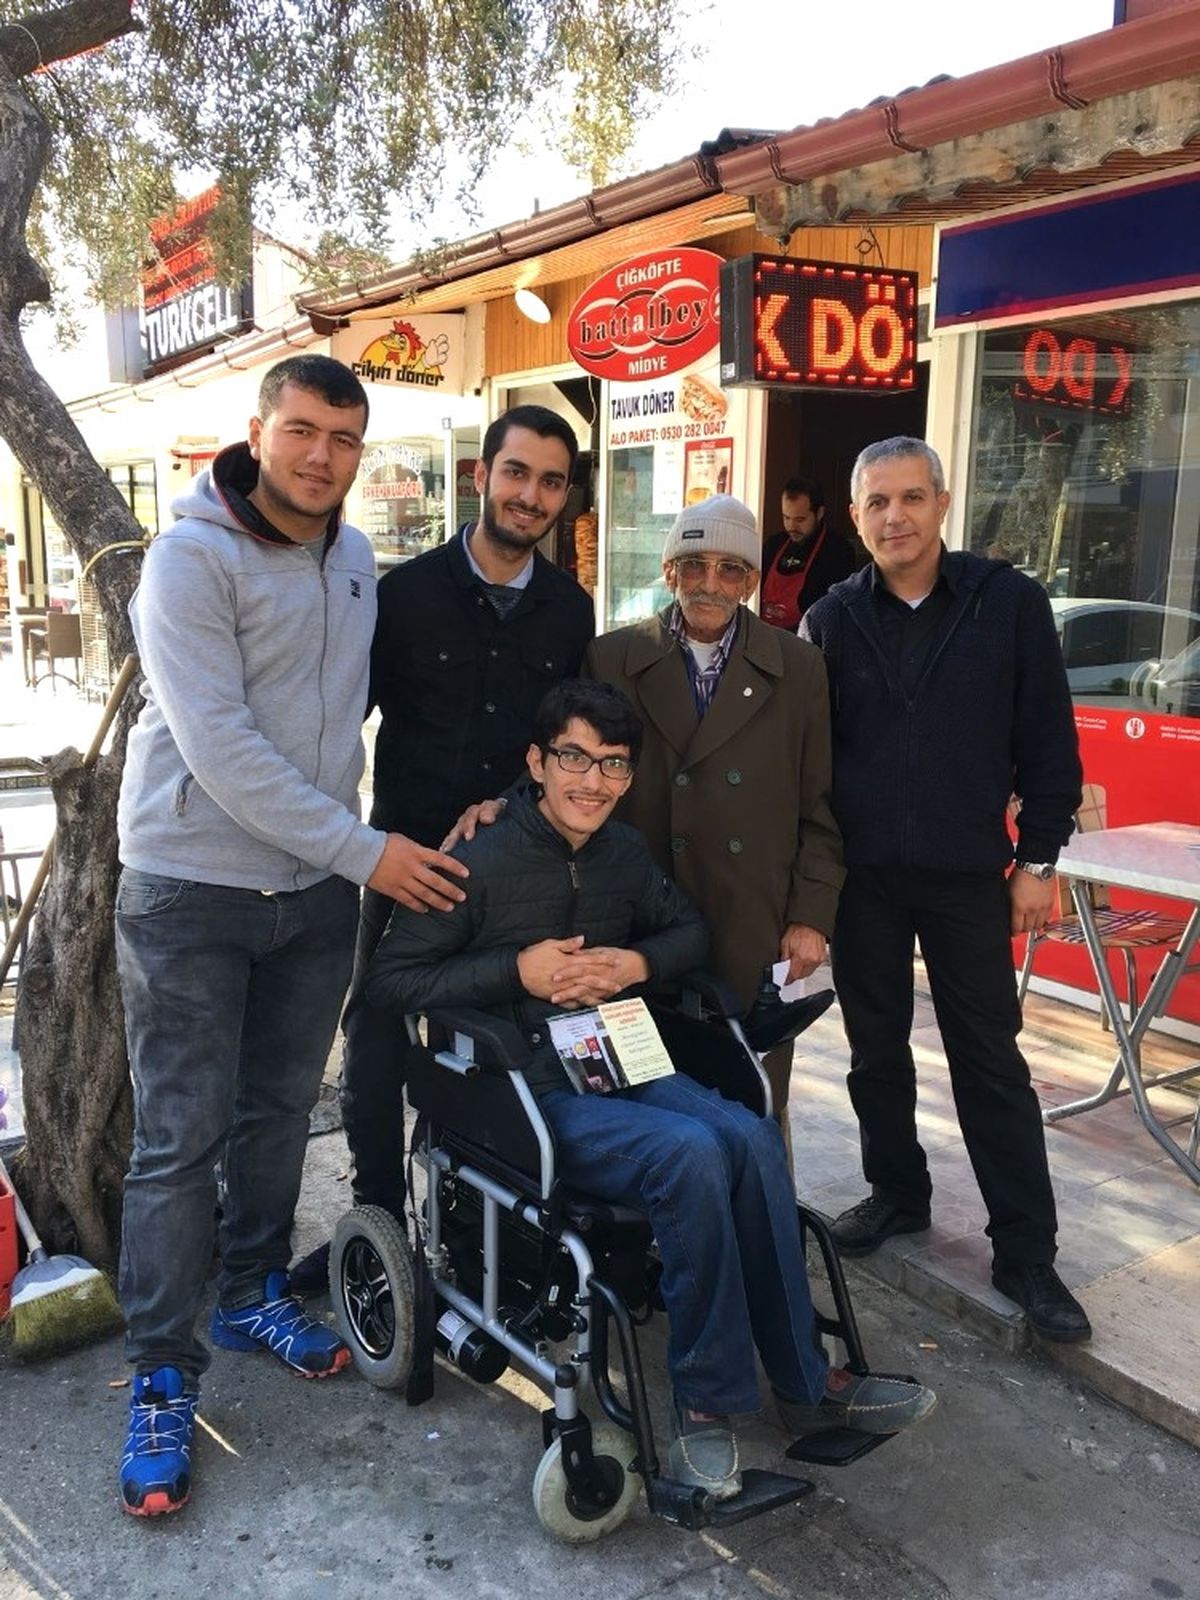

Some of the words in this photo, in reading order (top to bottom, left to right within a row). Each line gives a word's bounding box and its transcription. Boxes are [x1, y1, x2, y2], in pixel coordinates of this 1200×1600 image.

[813, 283, 905, 373] DÖ
[611, 396, 641, 420] TAVUK
[643, 388, 675, 416] DÖNER
[610, 431, 627, 446] ALO
